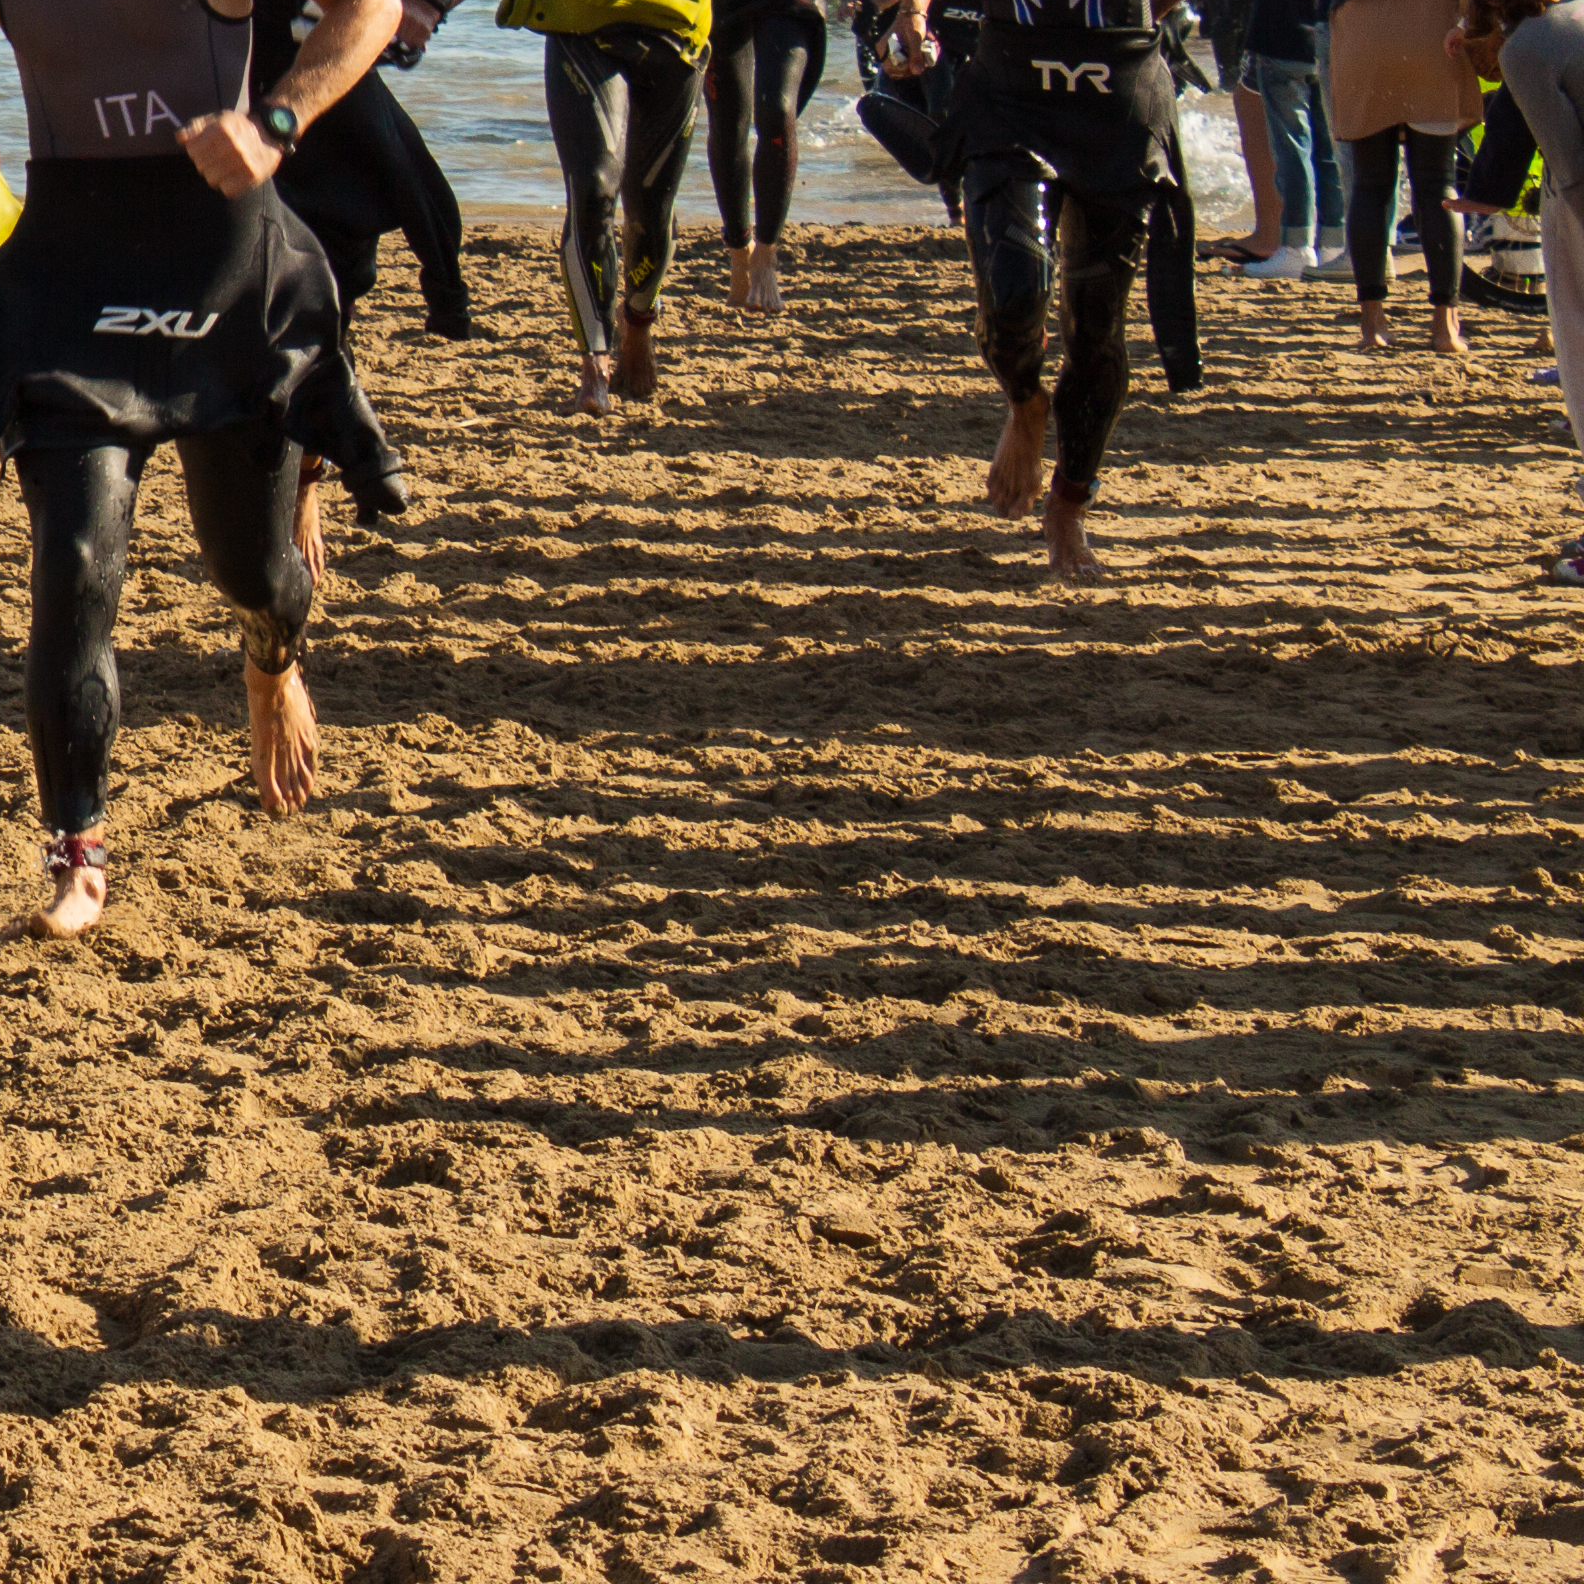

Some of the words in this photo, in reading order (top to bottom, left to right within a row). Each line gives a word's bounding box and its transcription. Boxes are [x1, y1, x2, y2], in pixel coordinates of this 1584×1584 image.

[1031, 59, 1113, 94] TYR
[93, 89, 183, 138] ITA
[93, 305, 220, 339] 2XU
